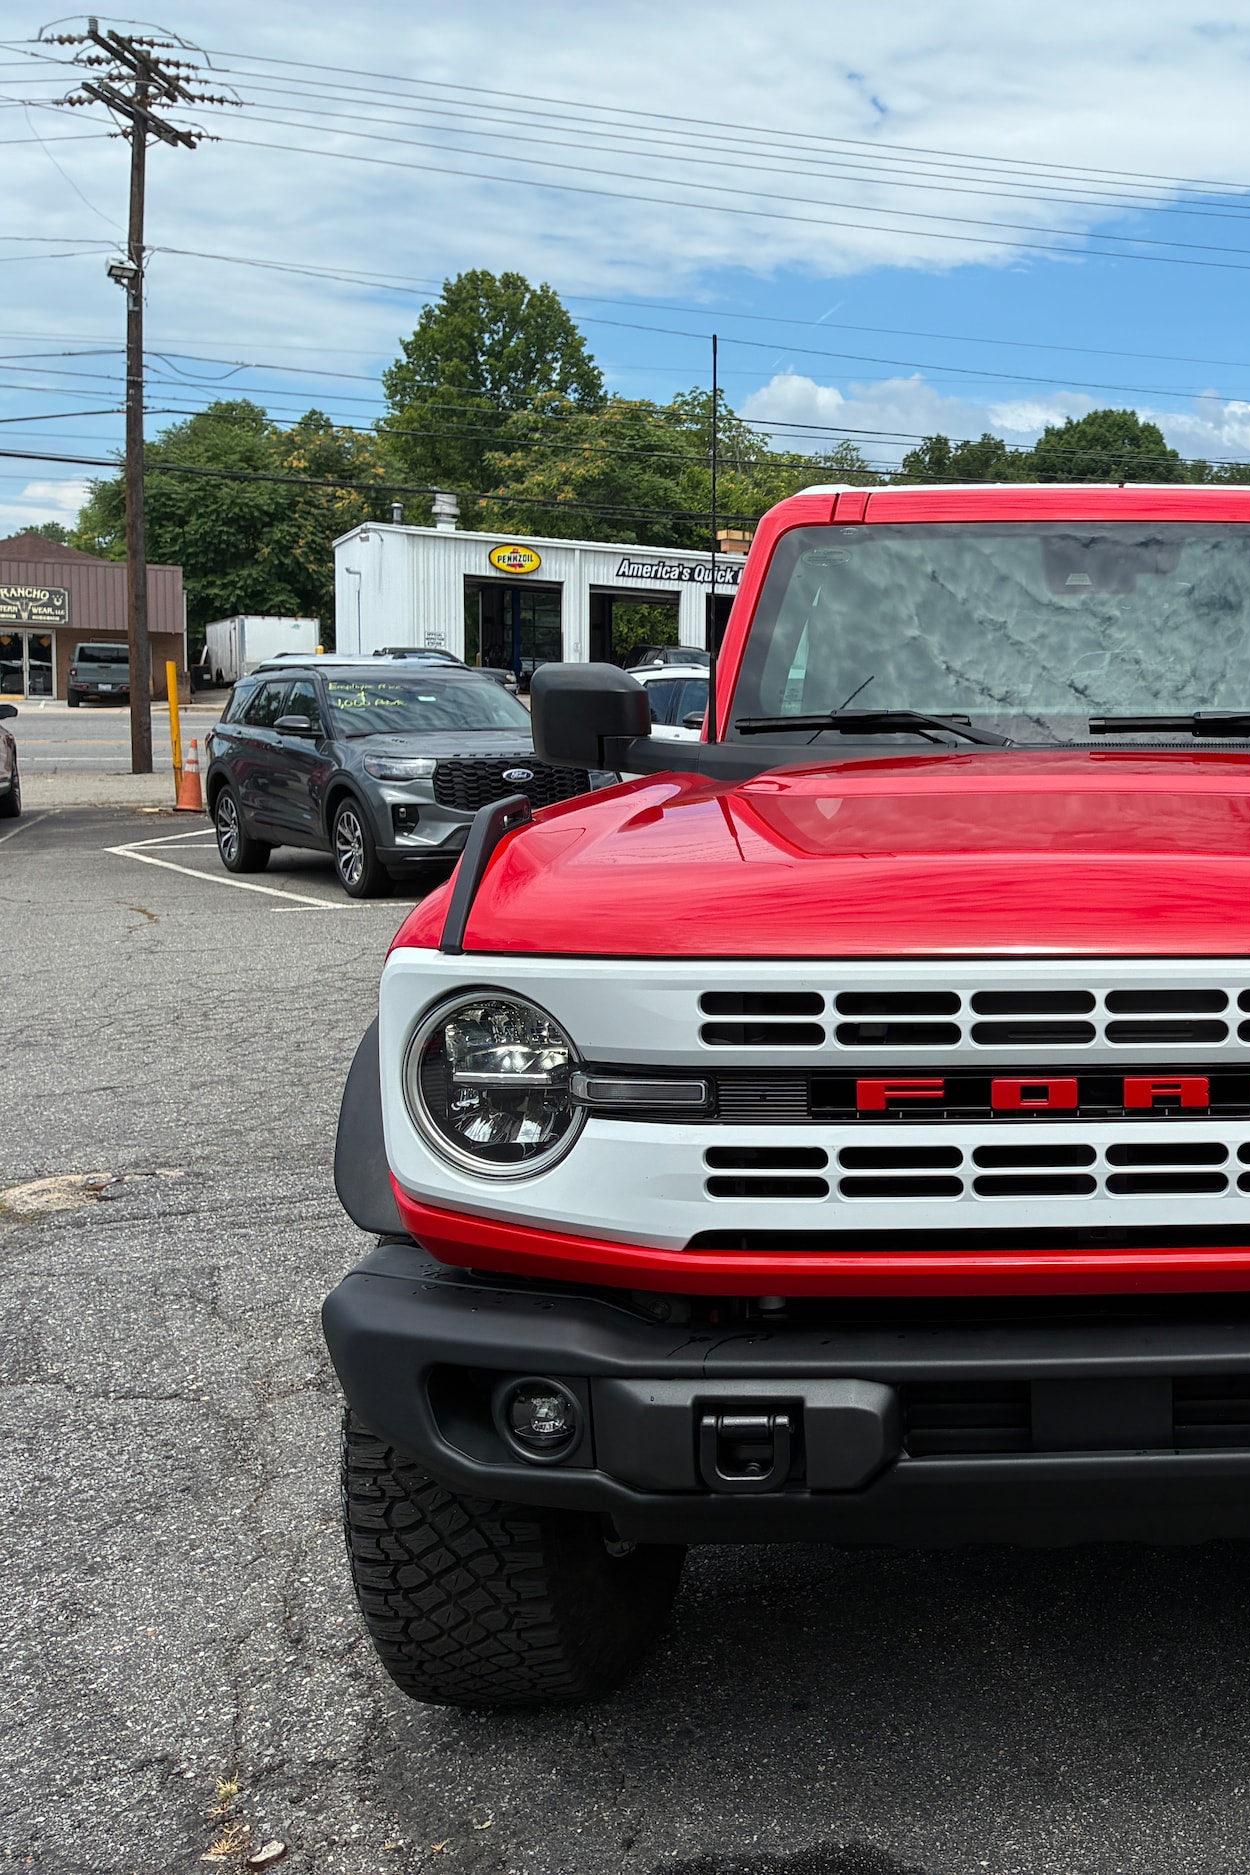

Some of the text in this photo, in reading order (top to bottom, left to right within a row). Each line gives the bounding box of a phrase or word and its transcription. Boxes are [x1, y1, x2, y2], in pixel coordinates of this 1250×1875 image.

[497, 554, 534, 564] PENNZOIL
[618, 559, 691, 581] America's
[694, 565, 735, 584] Quick
[0, 588, 49, 600] RANCHO
